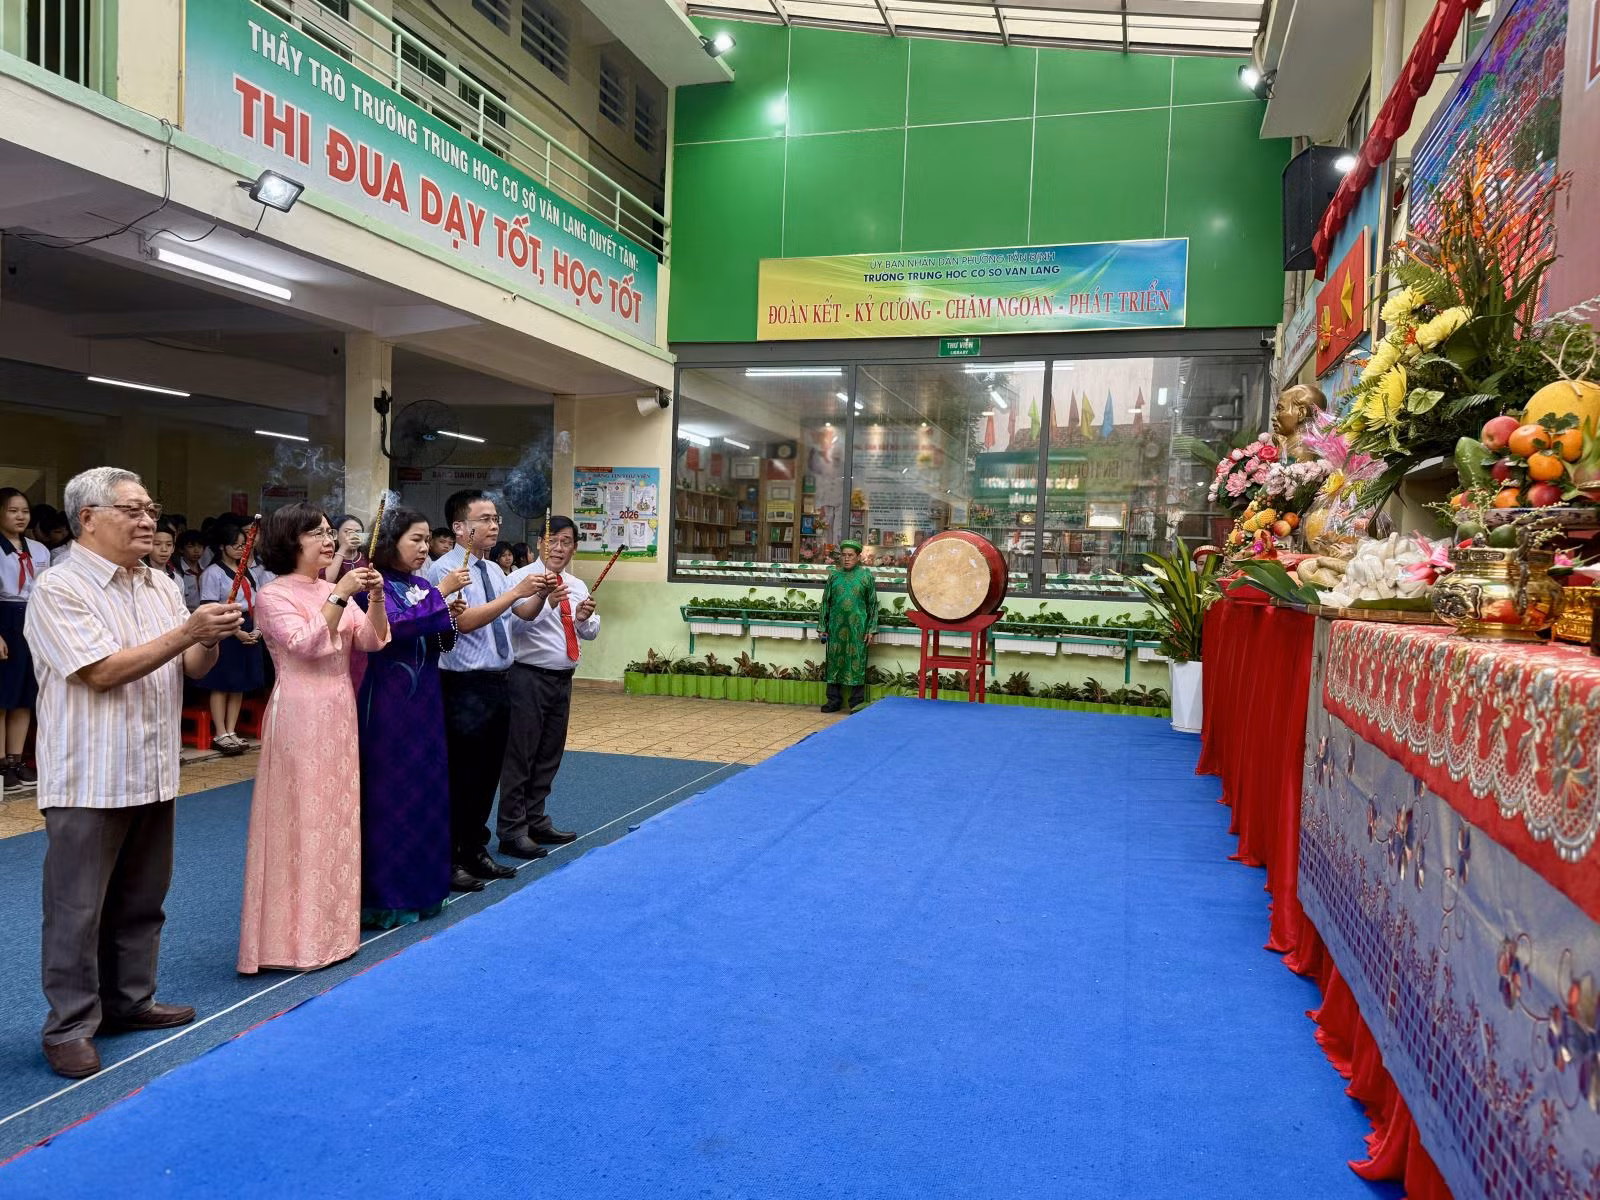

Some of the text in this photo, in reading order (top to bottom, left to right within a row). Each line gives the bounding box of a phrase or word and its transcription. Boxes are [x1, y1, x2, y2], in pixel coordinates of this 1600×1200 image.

[308, 57, 346, 102] TRÒ
[352, 83, 418, 145] TRƯỜNG
[422, 126, 469, 174] TRUNG
[473, 157, 499, 191] HỌC
[503, 175, 519, 203] CƠ
[522, 187, 537, 213] SỞ
[539, 197, 560, 227] VĂN
[563, 212, 587, 243] LANG
[589, 234, 617, 259] QUYẾT
[234, 74, 643, 325] THI ĐUA DẠY TỐT, HỌC TỐT
[885, 260, 905, 269] BAN
[907, 256, 935, 268] NHÂN
[908, 271, 943, 281] TRUNG
[946, 269, 968, 281] HỌC
[971, 268, 986, 278] CƠ
[1030, 265, 1060, 275] LANG
[768, 280, 1170, 324] ĐOÀN KẾT KỶ CƯƠNG CHĂM NGOAN PHÁT TRIỂN
[620, 511, 639, 519] 2026
